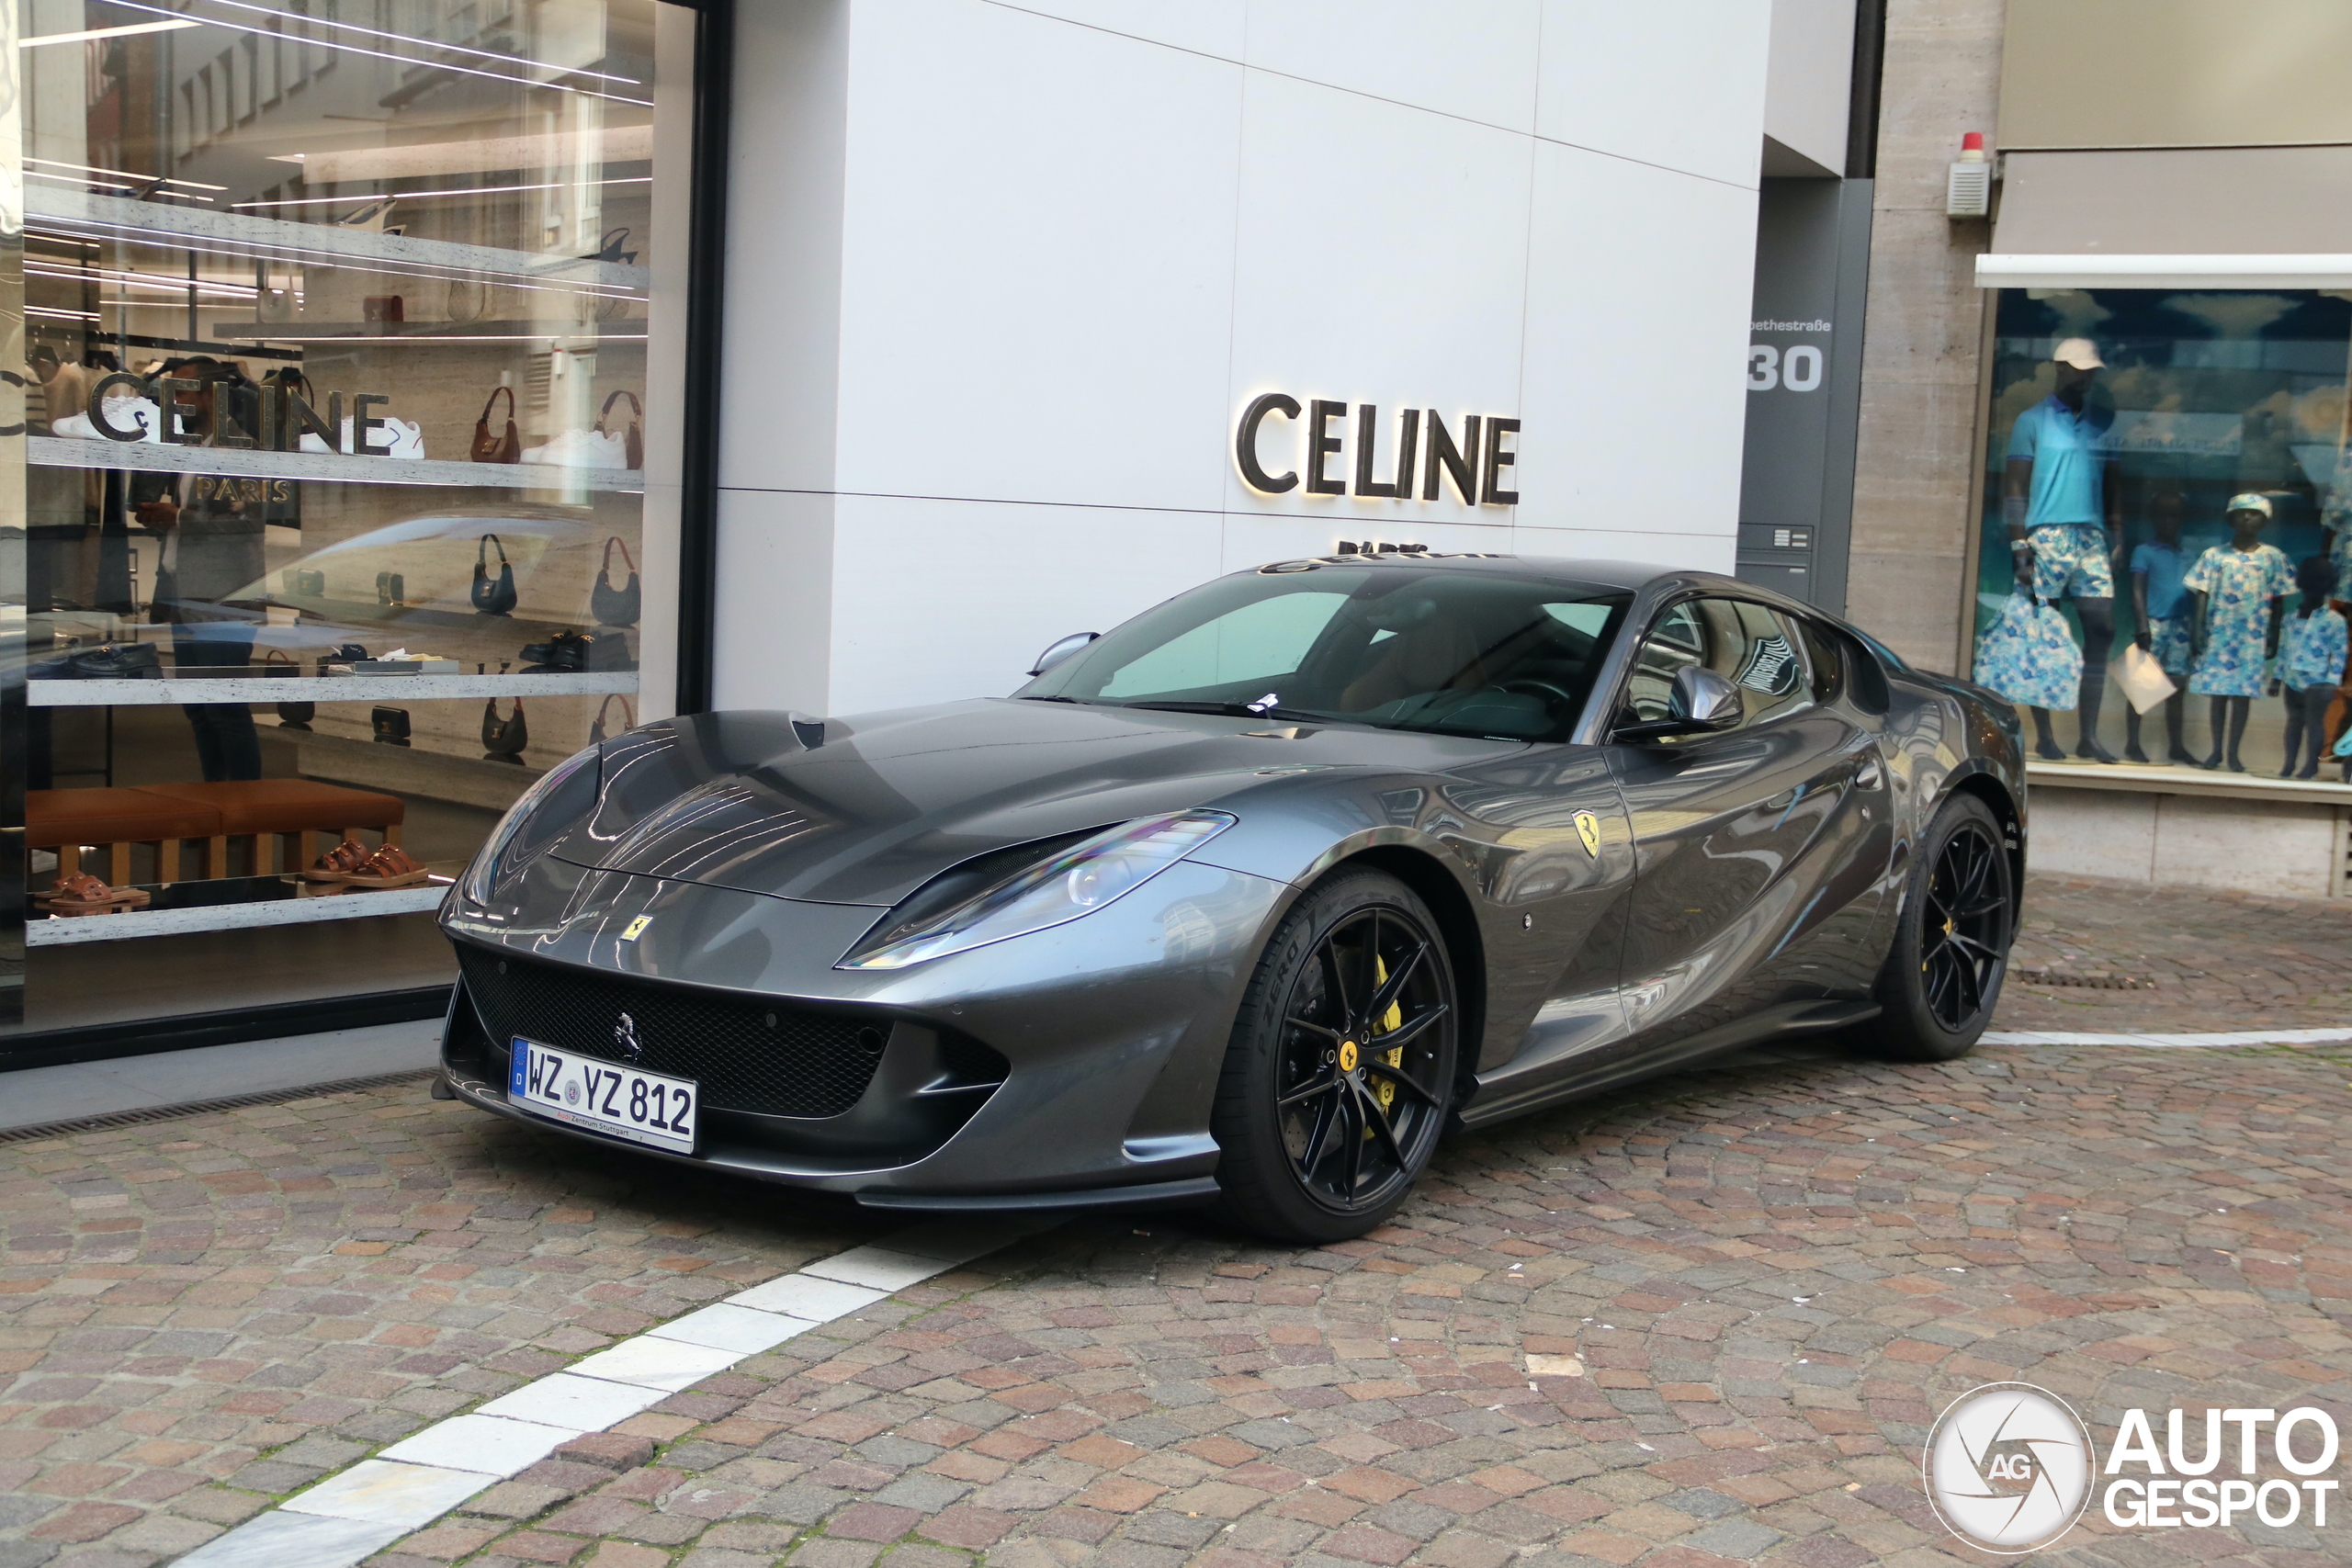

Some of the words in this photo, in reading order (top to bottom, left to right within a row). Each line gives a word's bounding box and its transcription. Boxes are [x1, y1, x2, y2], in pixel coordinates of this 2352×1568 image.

[1749, 319, 1831, 332] oethestraße
[1747, 344, 1823, 391] 30
[87, 372, 391, 456] CELINE
[1237, 393, 1521, 506] CELINE
[197, 477, 291, 503] PARIS
[1262, 939, 1299, 1029] ZERO
[1258, 1032, 1267, 1056] P
[515, 1073, 523, 1086] D
[529, 1049, 563, 1101] WZ
[583, 1065, 622, 1118] YZ
[629, 1078, 691, 1135] 812
[557, 1111, 571, 1121] Audi
[571, 1116, 598, 1128] Zentrum
[599, 1123, 629, 1136] Stuttgart
